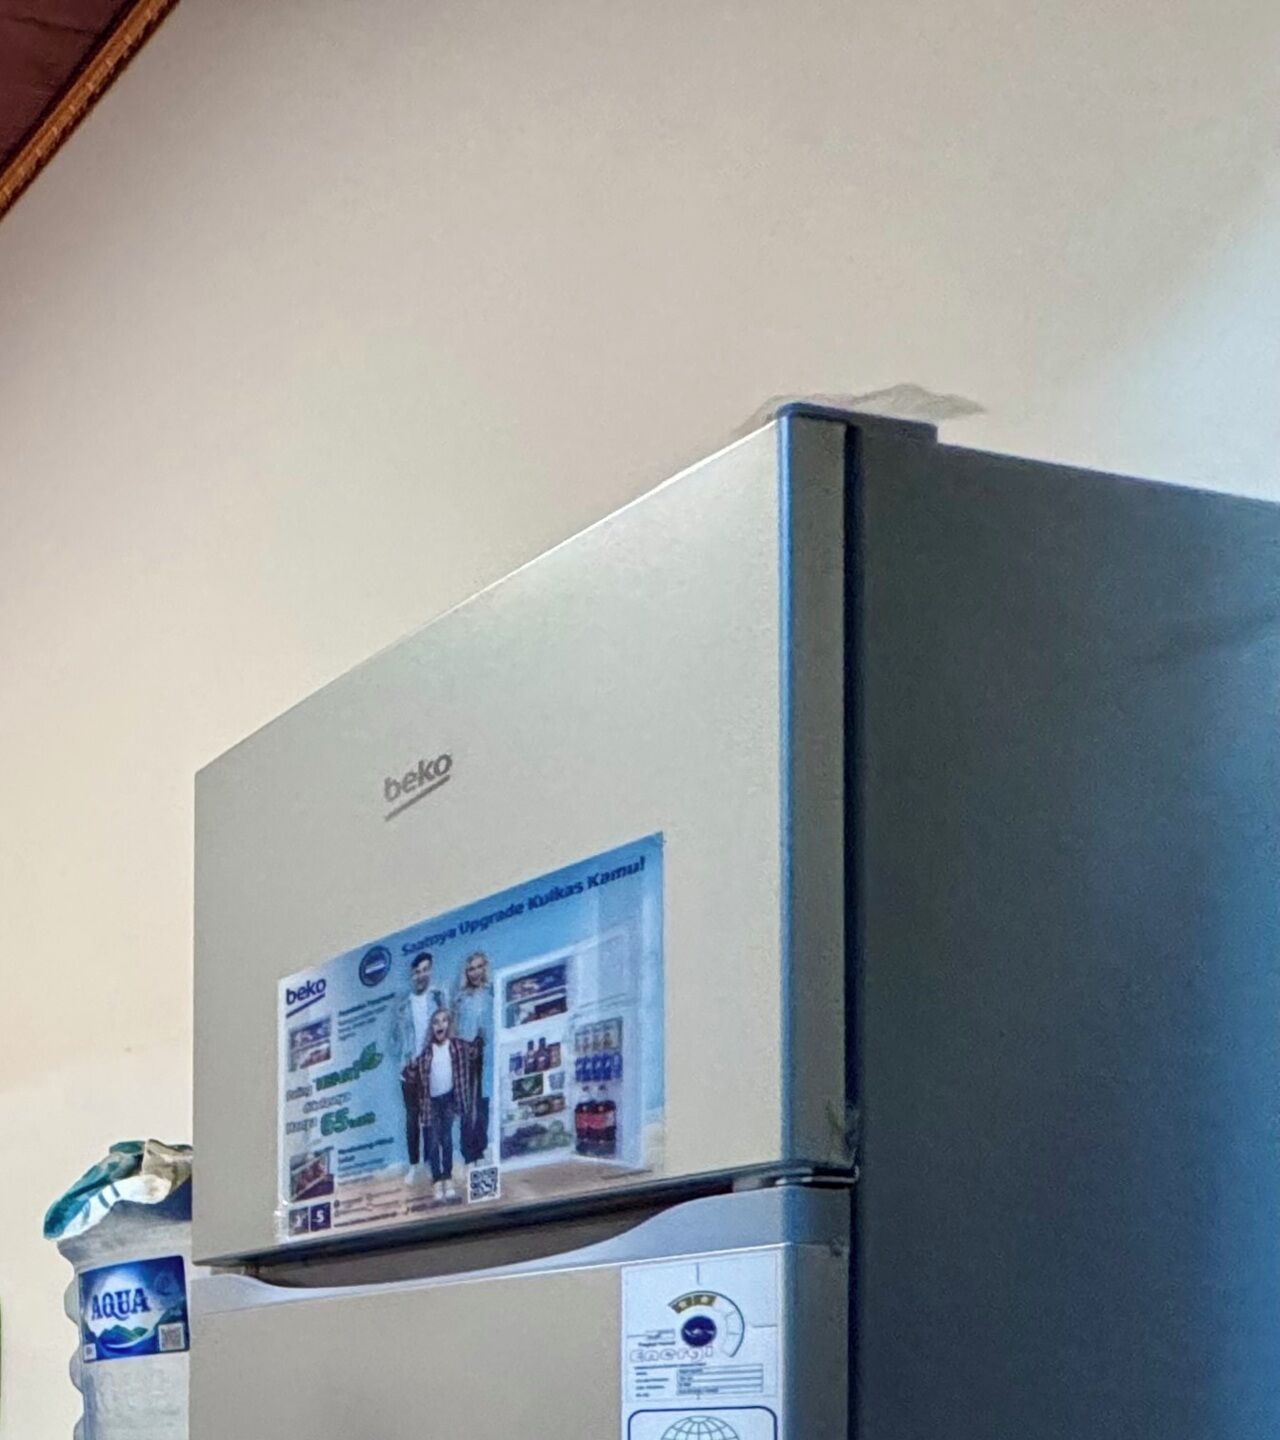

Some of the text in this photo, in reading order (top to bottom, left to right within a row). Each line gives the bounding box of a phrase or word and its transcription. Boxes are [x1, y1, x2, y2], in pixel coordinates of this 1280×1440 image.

[384, 753, 453, 804] beko
[401, 856, 646, 956] Saatnya Upgrade Kulkas Kamu!
[286, 978, 327, 1006] beko
[91, 1287, 151, 1322] AQUA
